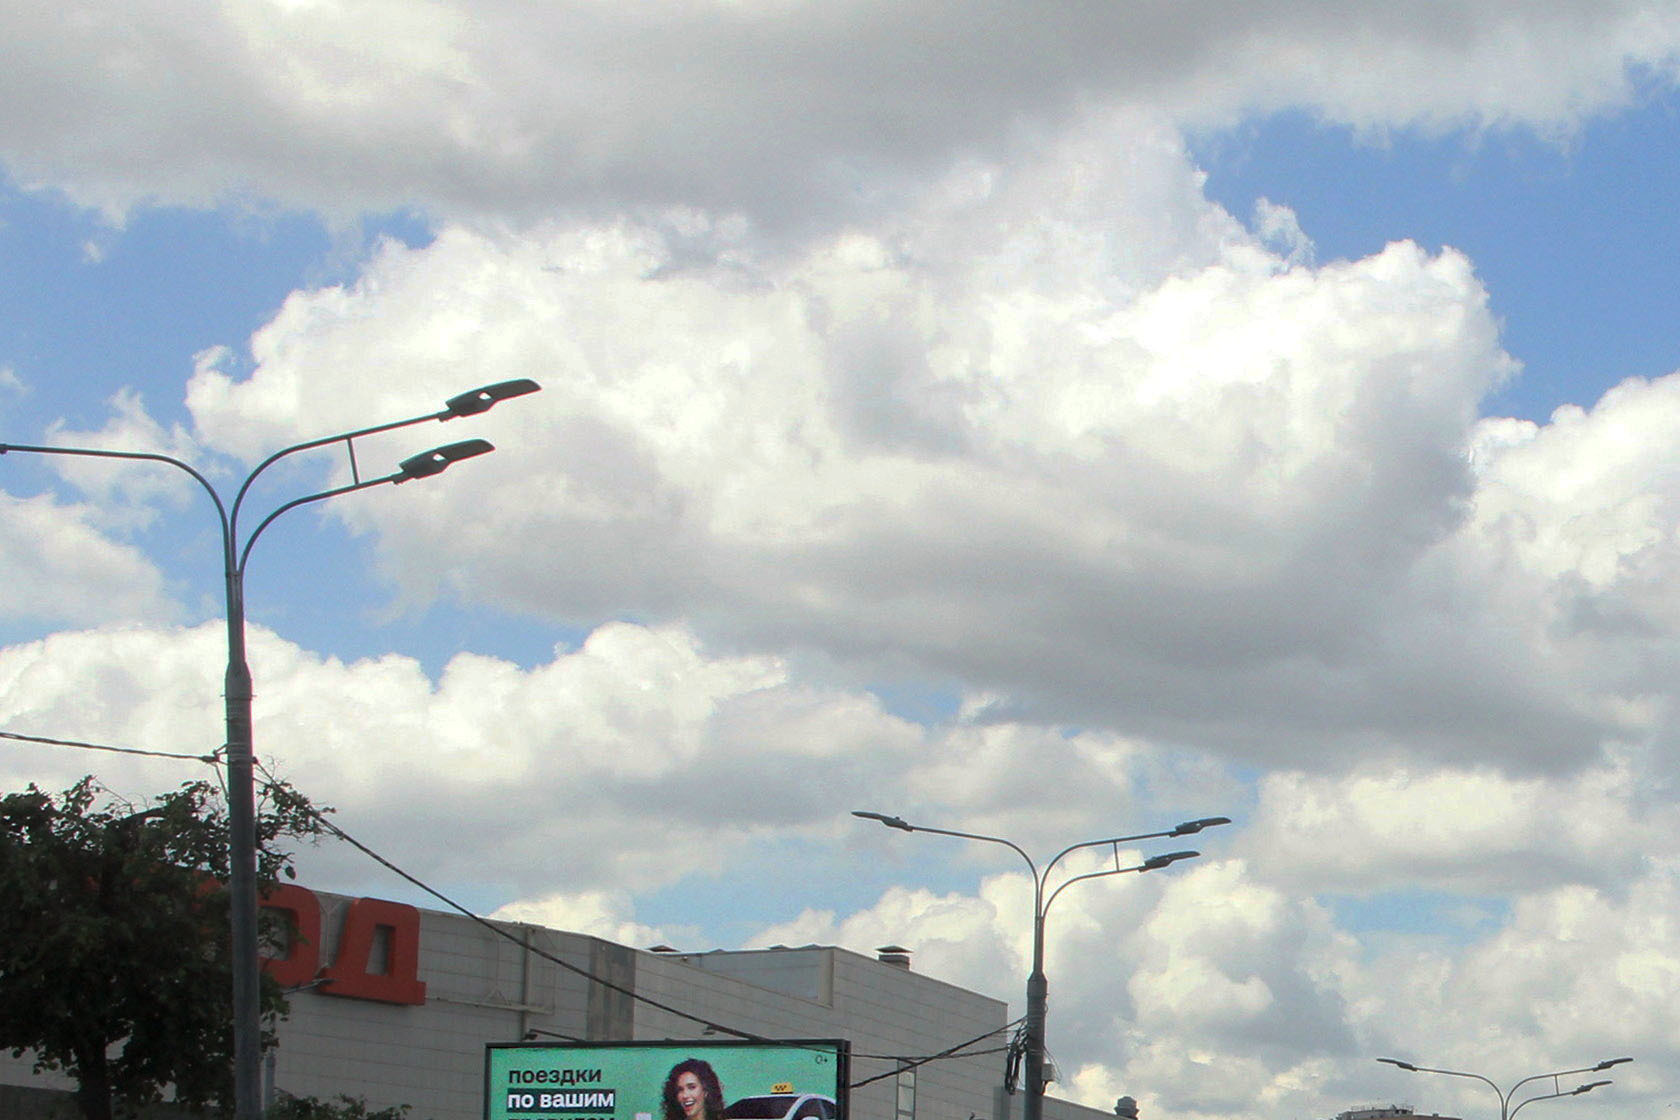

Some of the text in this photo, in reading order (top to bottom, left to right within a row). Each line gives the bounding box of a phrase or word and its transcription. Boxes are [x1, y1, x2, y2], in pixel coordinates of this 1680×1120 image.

[508, 1067, 602, 1085] поездки
[507, 1092, 615, 1108] по вашим
